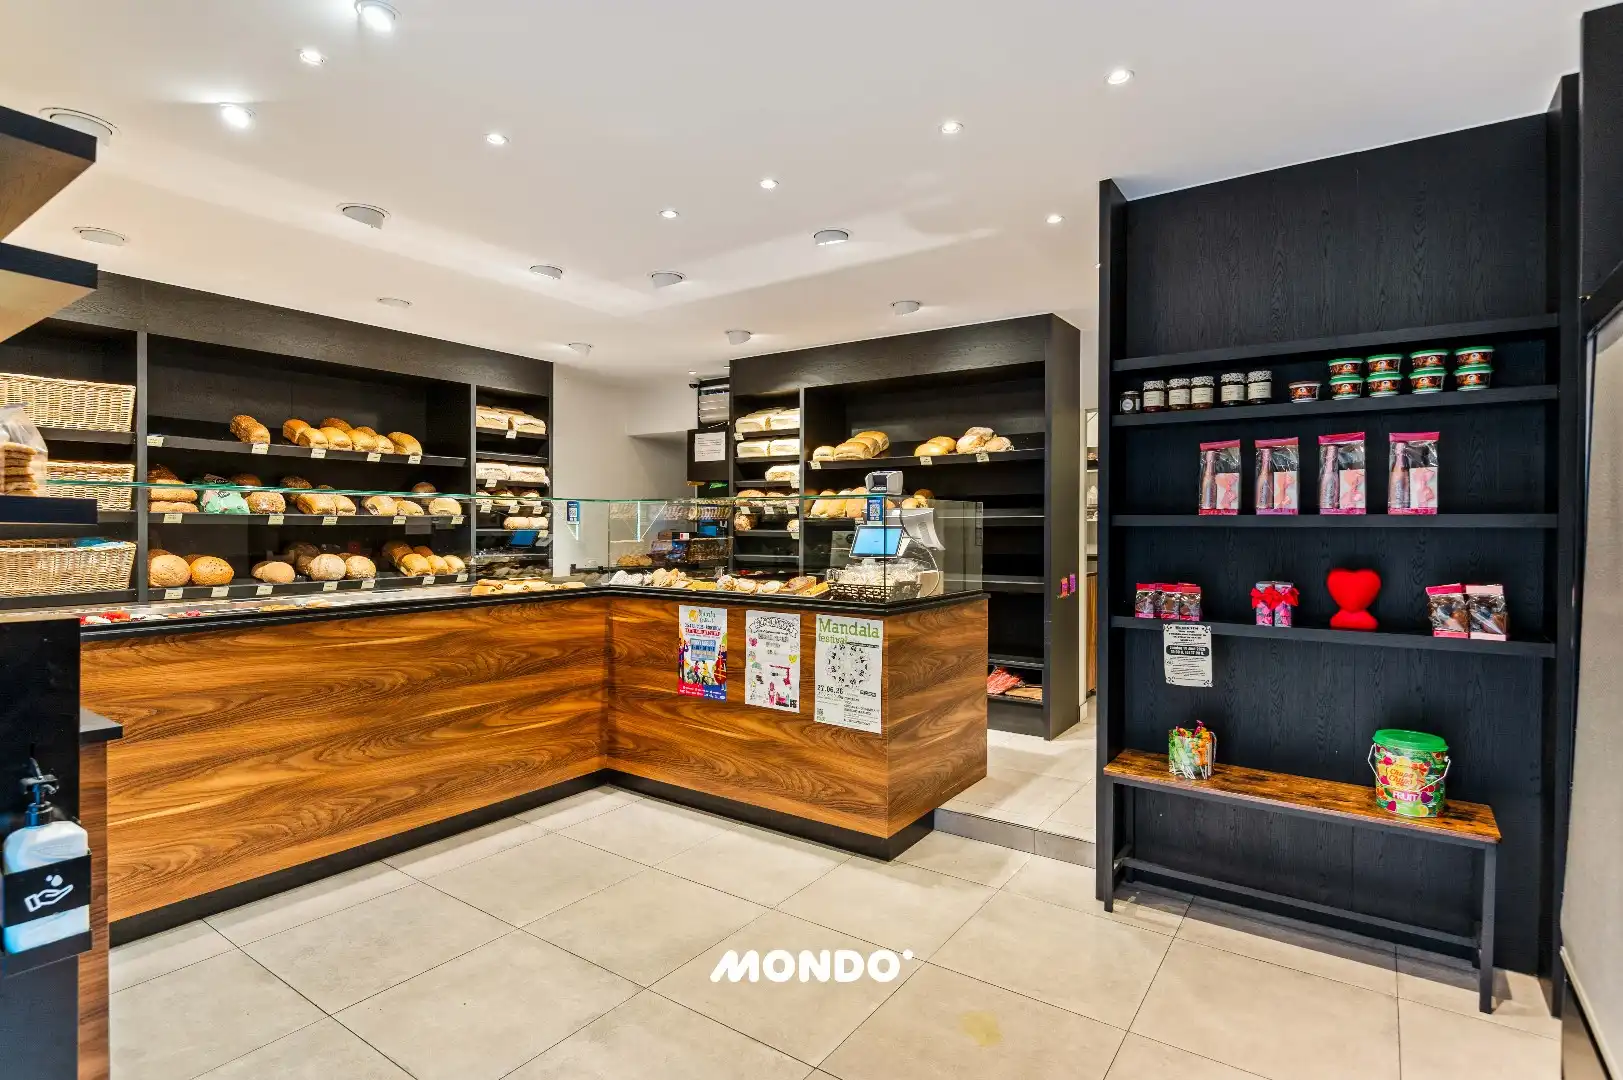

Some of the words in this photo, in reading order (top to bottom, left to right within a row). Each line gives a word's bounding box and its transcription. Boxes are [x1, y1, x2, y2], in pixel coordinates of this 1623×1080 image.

[818, 617, 880, 639] Mandala
[818, 633, 848, 645] festival
[1393, 791, 1419, 802] FRUIT
